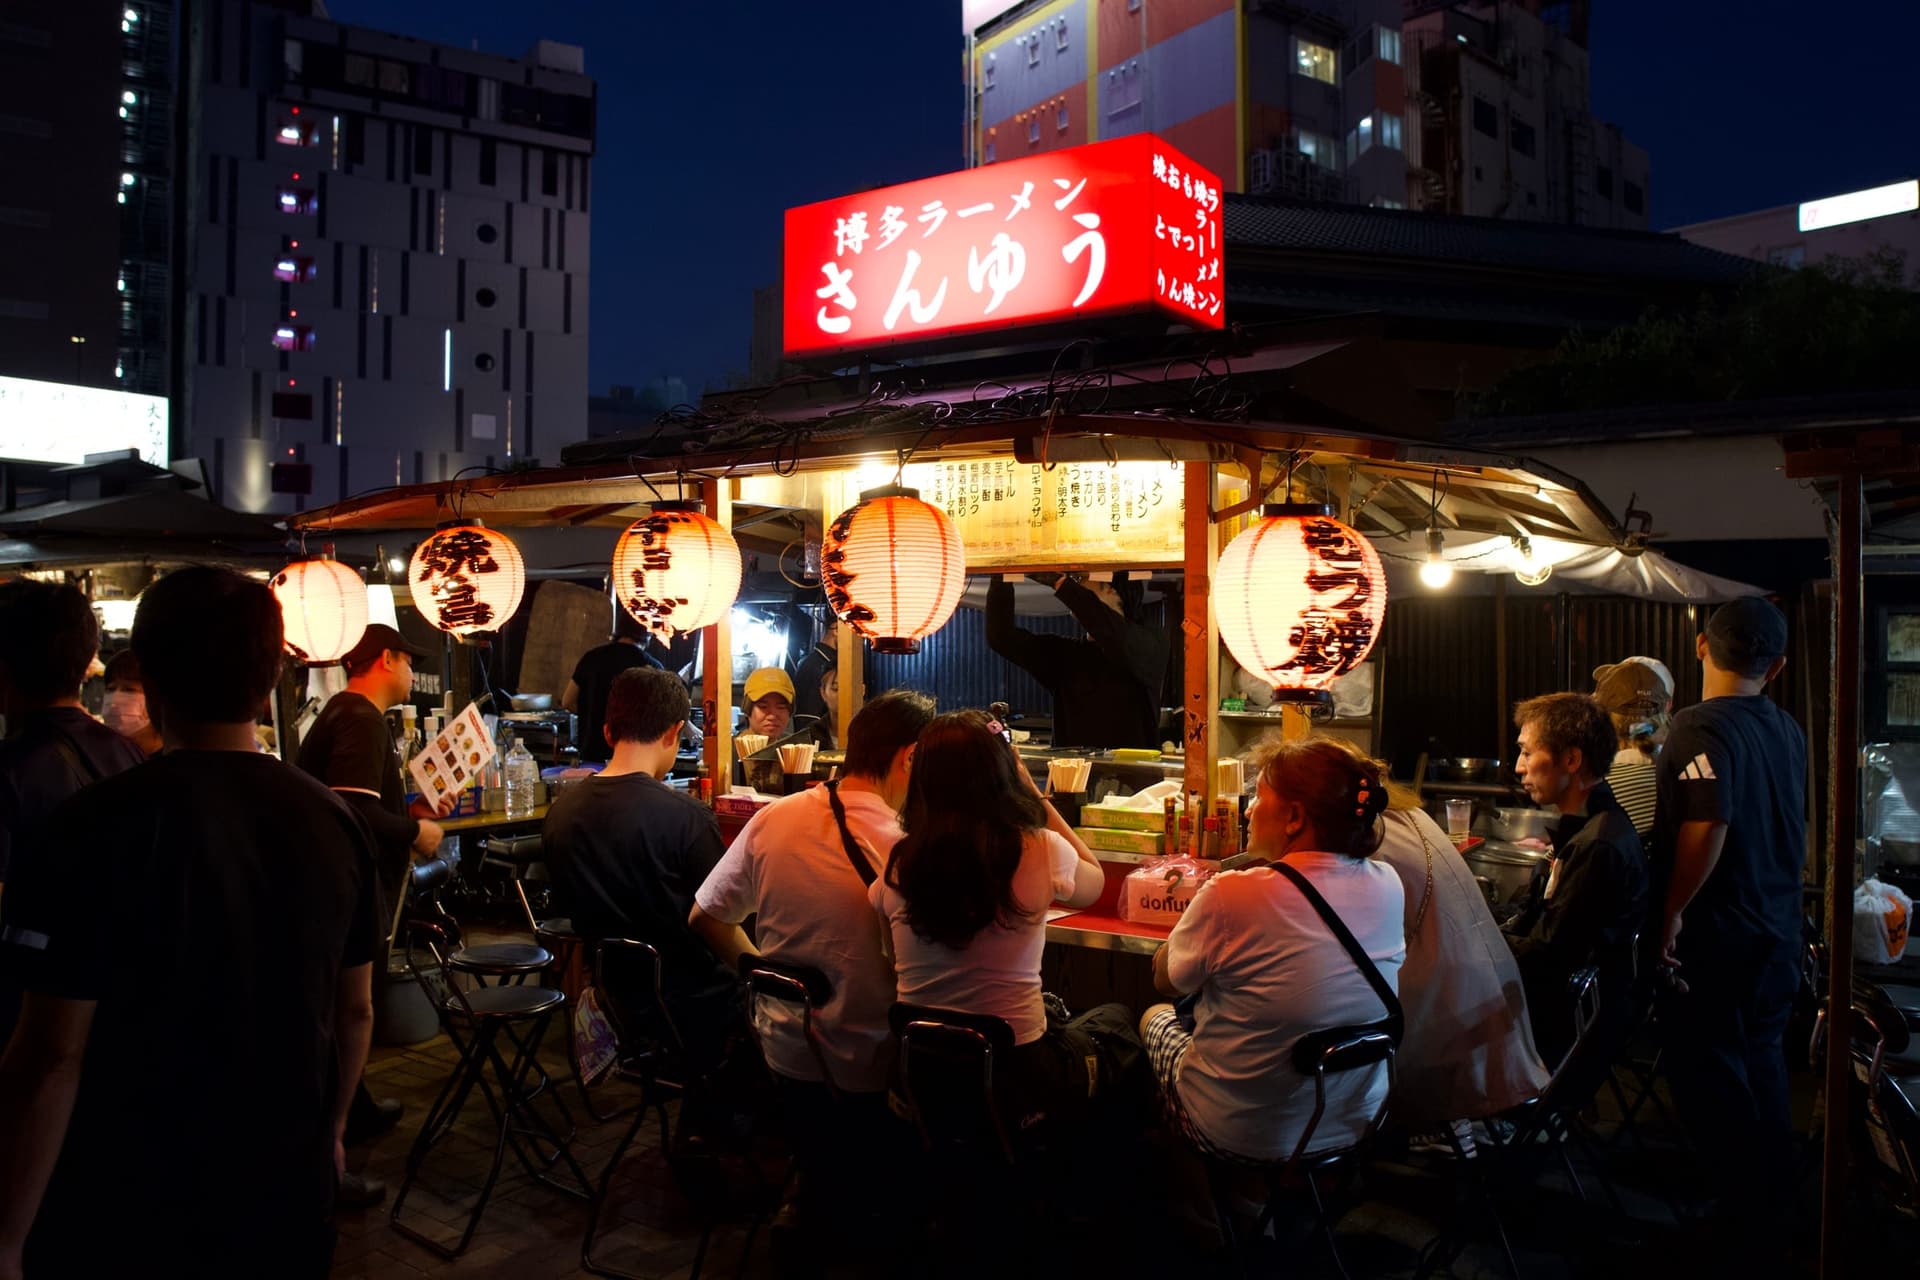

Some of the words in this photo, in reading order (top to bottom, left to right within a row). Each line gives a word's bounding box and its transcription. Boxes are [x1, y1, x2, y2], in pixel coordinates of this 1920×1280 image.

[815, 211, 1106, 334] さんゆう
[834, 176, 1087, 257] 博多ラーメン
[1152, 153, 1168, 297] 焼とり
[1166, 163, 1183, 299] おでん
[1183, 173, 1197, 309] もつ焼
[1205, 187, 1222, 316] ラーメン
[1006, 459, 1017, 498] ビール
[1070, 462, 1081, 509] つ焼き
